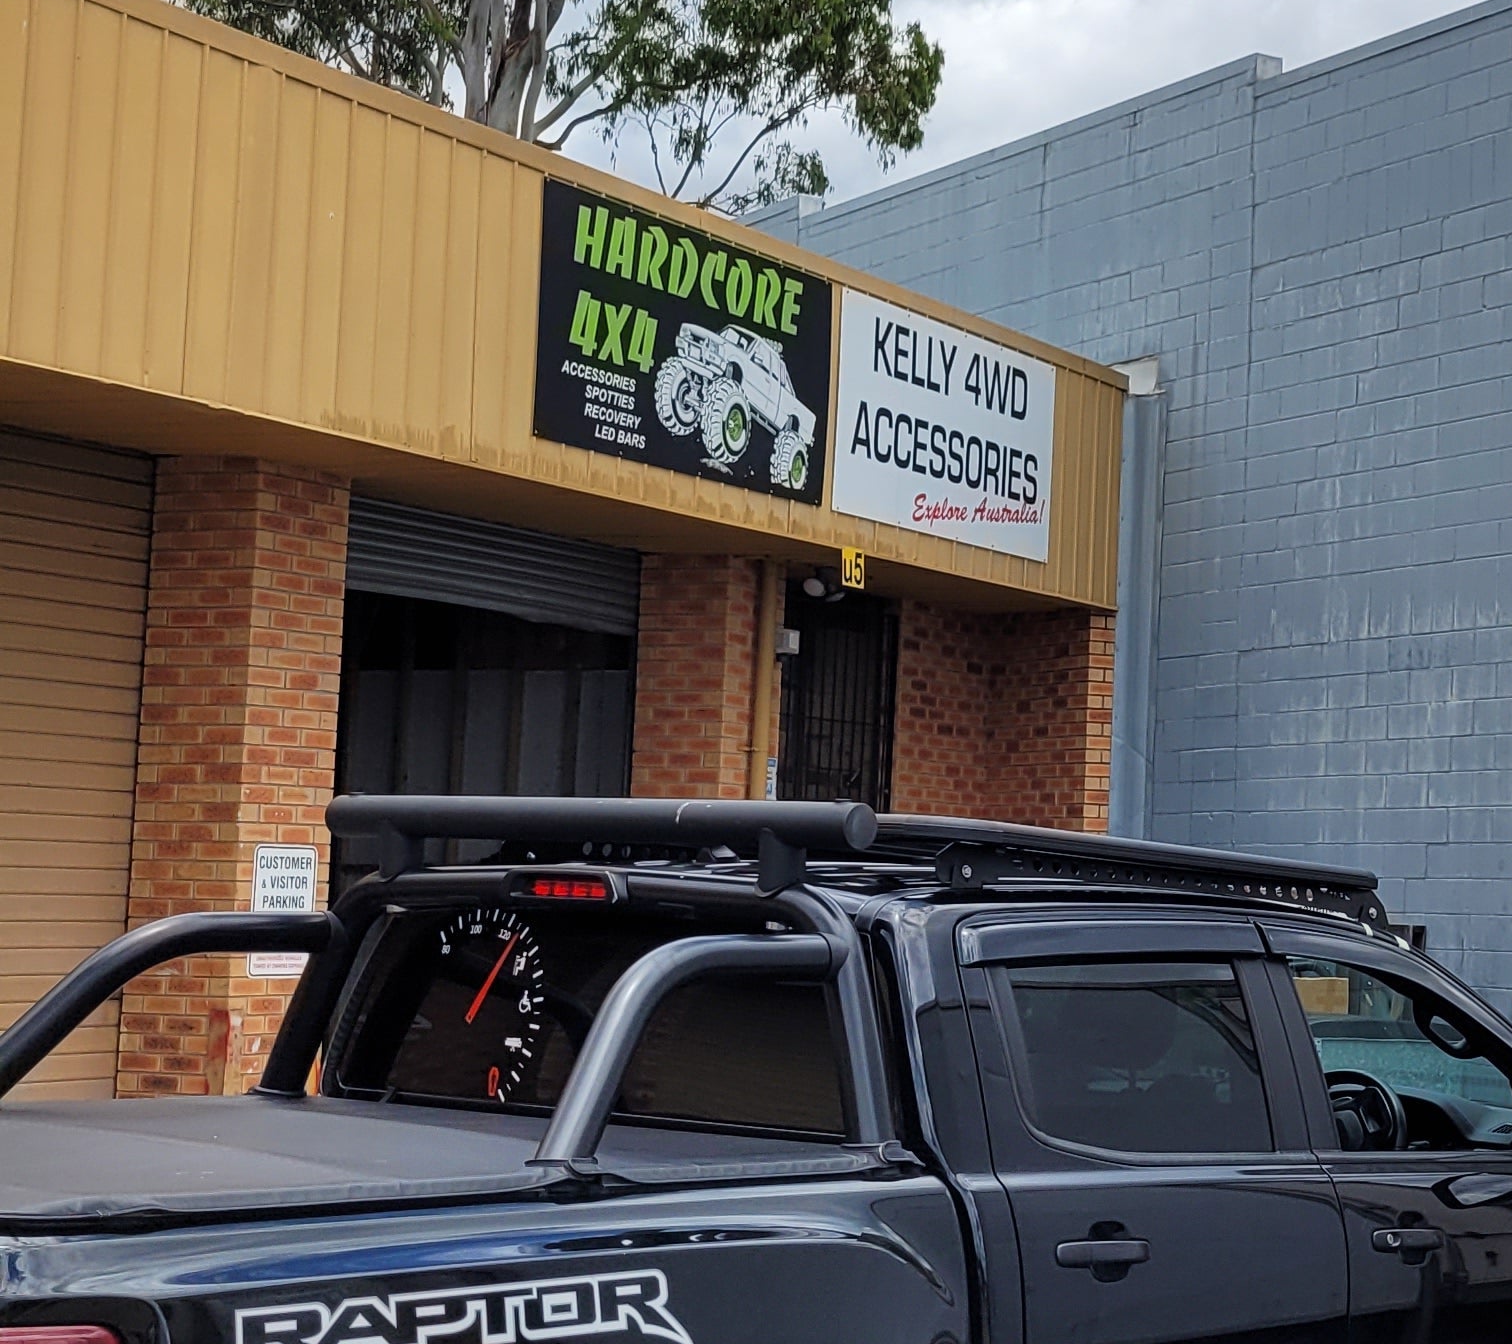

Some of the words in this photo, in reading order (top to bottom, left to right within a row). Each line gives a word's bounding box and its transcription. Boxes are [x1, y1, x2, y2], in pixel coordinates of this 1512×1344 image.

[573, 204, 804, 336] HARDCORE
[569, 289, 659, 374] 4X4
[561, 360, 637, 393] ACCESSORIES
[873, 316, 958, 396] KELLY
[964, 352, 1028, 421] 4WD
[584, 385, 636, 411] SPOTTIES
[584, 403, 642, 430] RECOVERY
[594, 424, 616, 442] LED
[616, 429, 647, 449] BARS
[850, 400, 1038, 506] ACCESSORIES
[912, 492, 969, 527] Explore
[970, 496, 1046, 525] Australia!
[843, 553, 864, 586] u5
[259, 855, 313, 870] CUSTOMER
[261, 878, 267, 889] &
[270, 875, 309, 890] VISITOR
[262, 895, 305, 909] PARKING
[469, 924, 483, 935] 100
